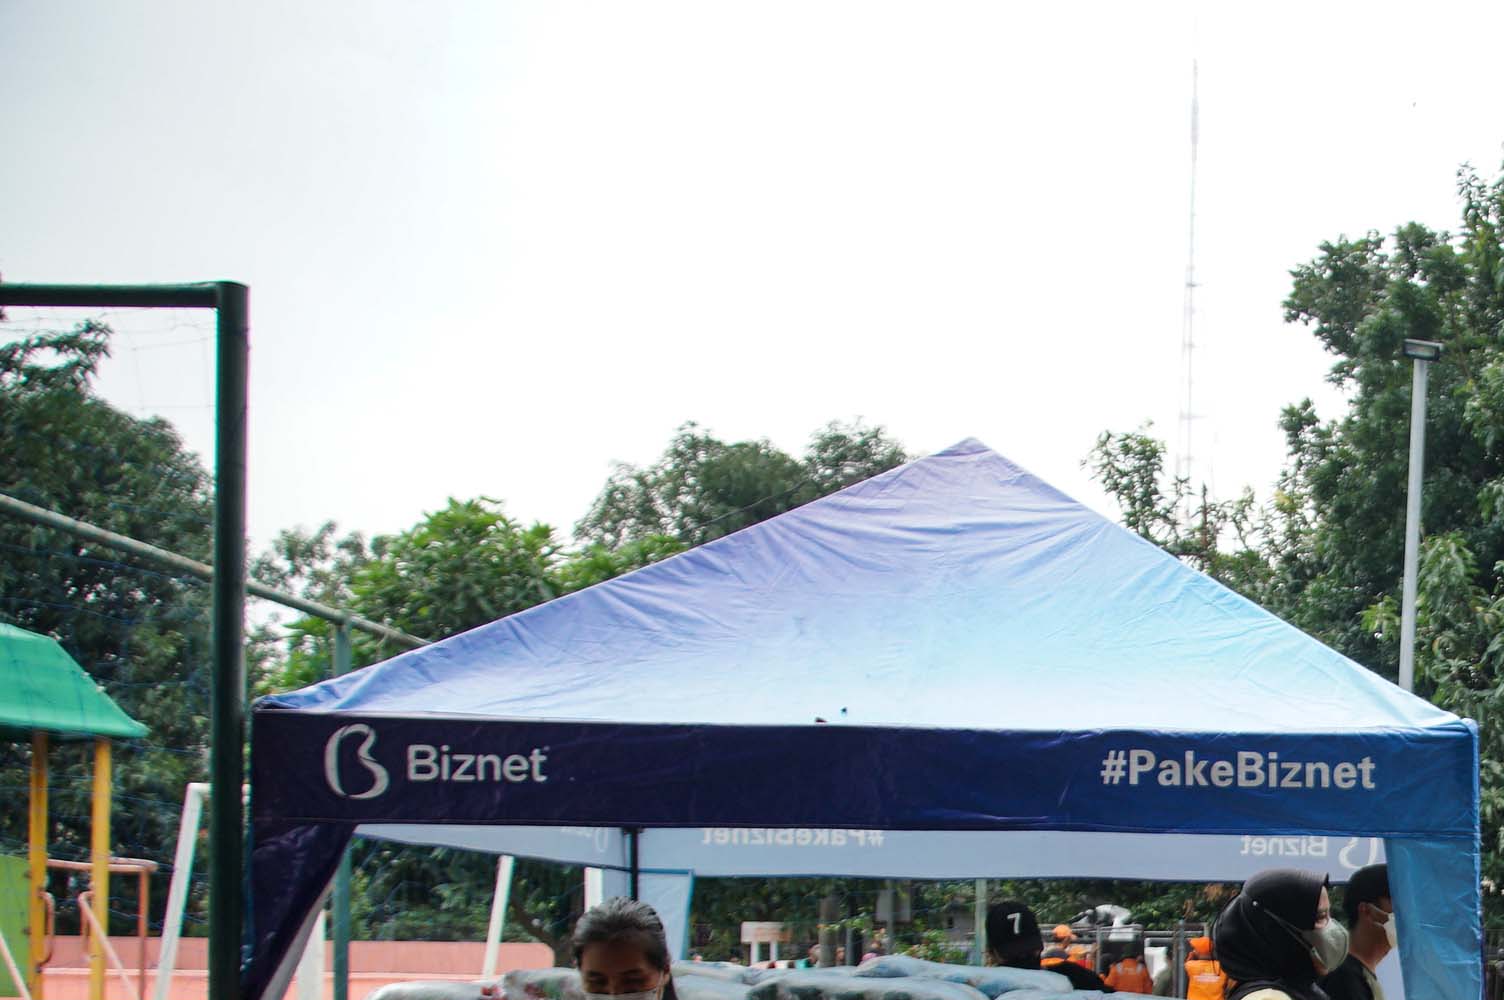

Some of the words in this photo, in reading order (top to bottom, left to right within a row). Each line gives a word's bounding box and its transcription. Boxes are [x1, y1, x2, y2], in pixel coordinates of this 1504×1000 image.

[407, 744, 548, 782] Biznet
[1100, 749, 1376, 789] #PakeBiznet
[1007, 912, 1022, 934] 7
